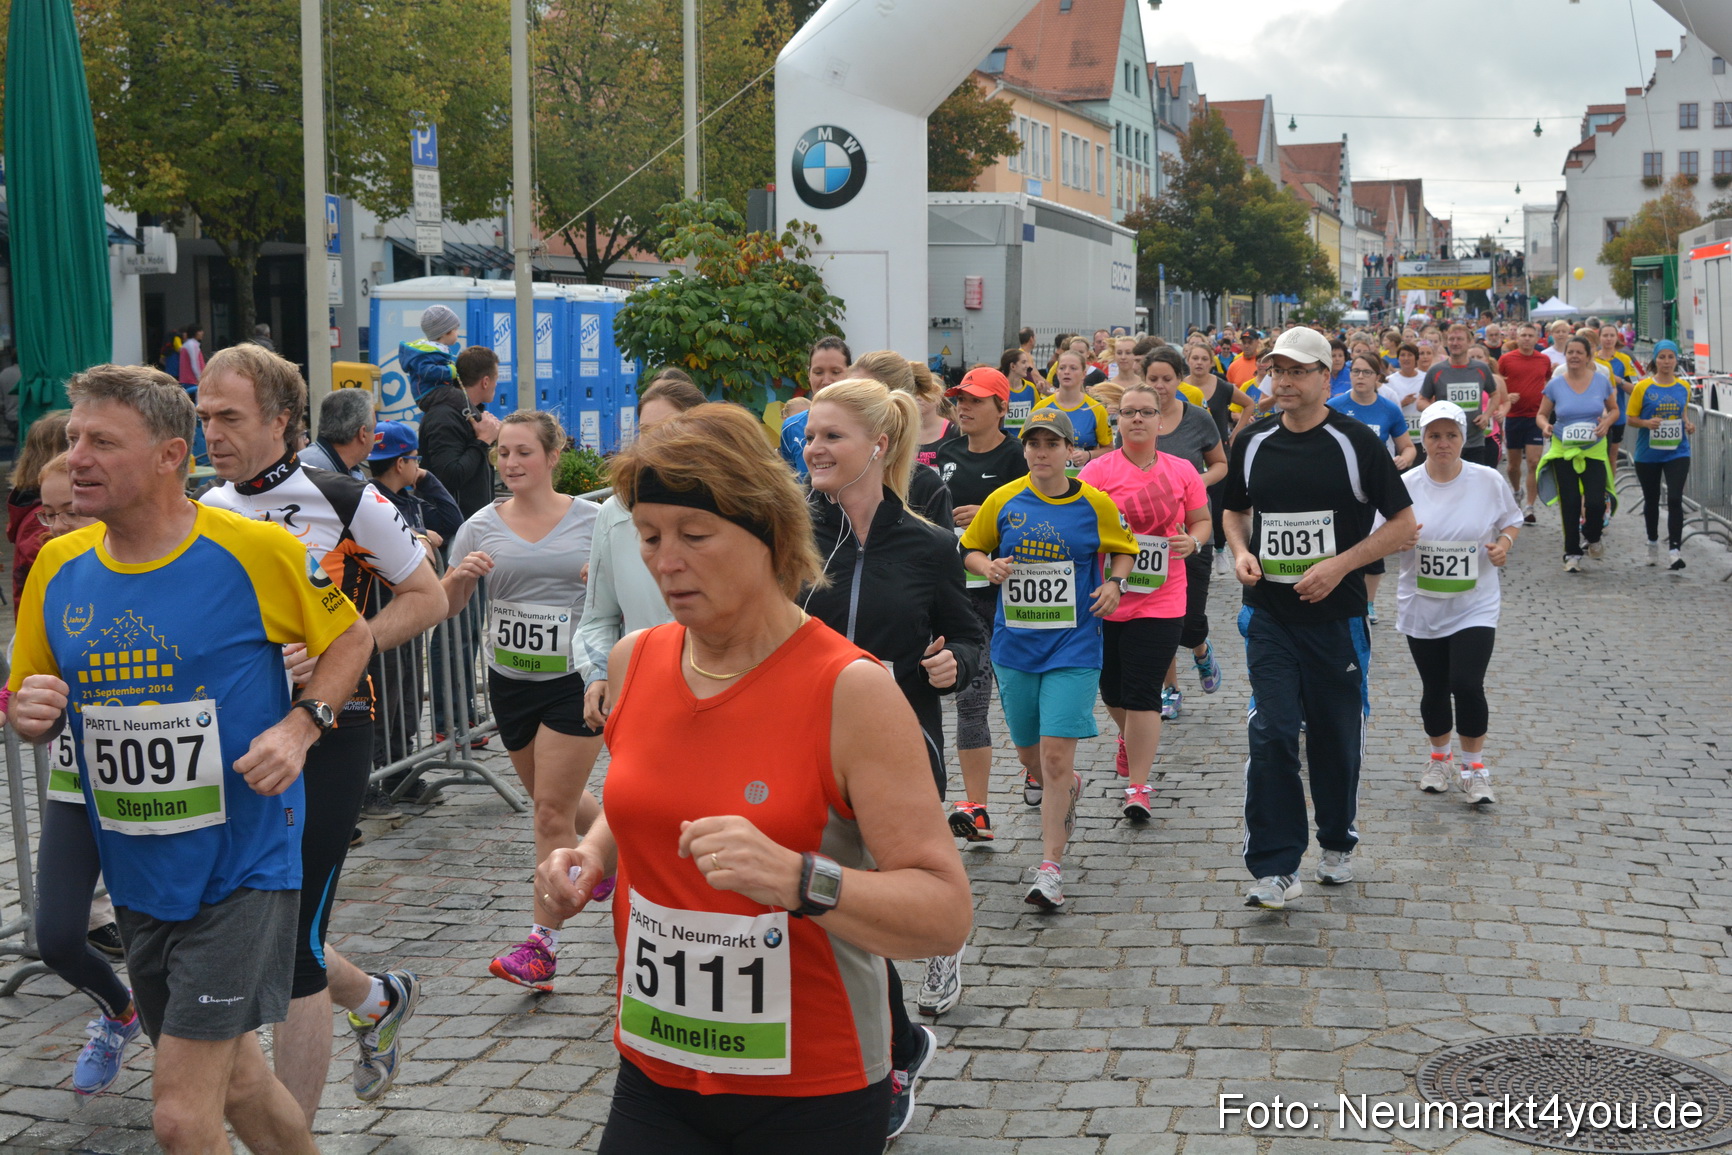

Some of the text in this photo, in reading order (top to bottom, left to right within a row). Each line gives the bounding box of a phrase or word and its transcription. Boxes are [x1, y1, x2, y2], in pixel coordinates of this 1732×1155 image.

[797, 127, 861, 155] BMW
[361, 279, 369, 296] 3
[1428, 278, 1461, 287] START
[1450, 389, 1477, 401] 5019
[1008, 407, 1029, 419] 5017
[1566, 428, 1593, 440] 5027
[1653, 427, 1680, 439] 5538
[265, 463, 289, 483] TYR
[1122, 472, 1181, 538] UN
[1263, 518, 1320, 527] PARTL Neumarkt
[1267, 529, 1325, 556] 5031
[1137, 549, 1163, 572] 80
[1420, 554, 1469, 577] 5521
[1008, 578, 1068, 604] 5082
[68, 616, 87, 625] Jahre
[494, 607, 556, 621] PARTL Neumarkt
[1016, 609, 1061, 620] Katharina
[497, 619, 559, 651] 5051
[512, 655, 541, 672] Sonja
[82, 684, 175, 699] 21.September 2014
[85, 718, 121, 731] PARTL
[123, 717, 191, 732] Neumarkt
[96, 734, 205, 786] 5097
[116, 797, 188, 821] Stephan
[631, 907, 757, 948] PARTL Neumarkt
[635, 936, 764, 1014] 5111
[650, 1016, 746, 1053] Annelies
